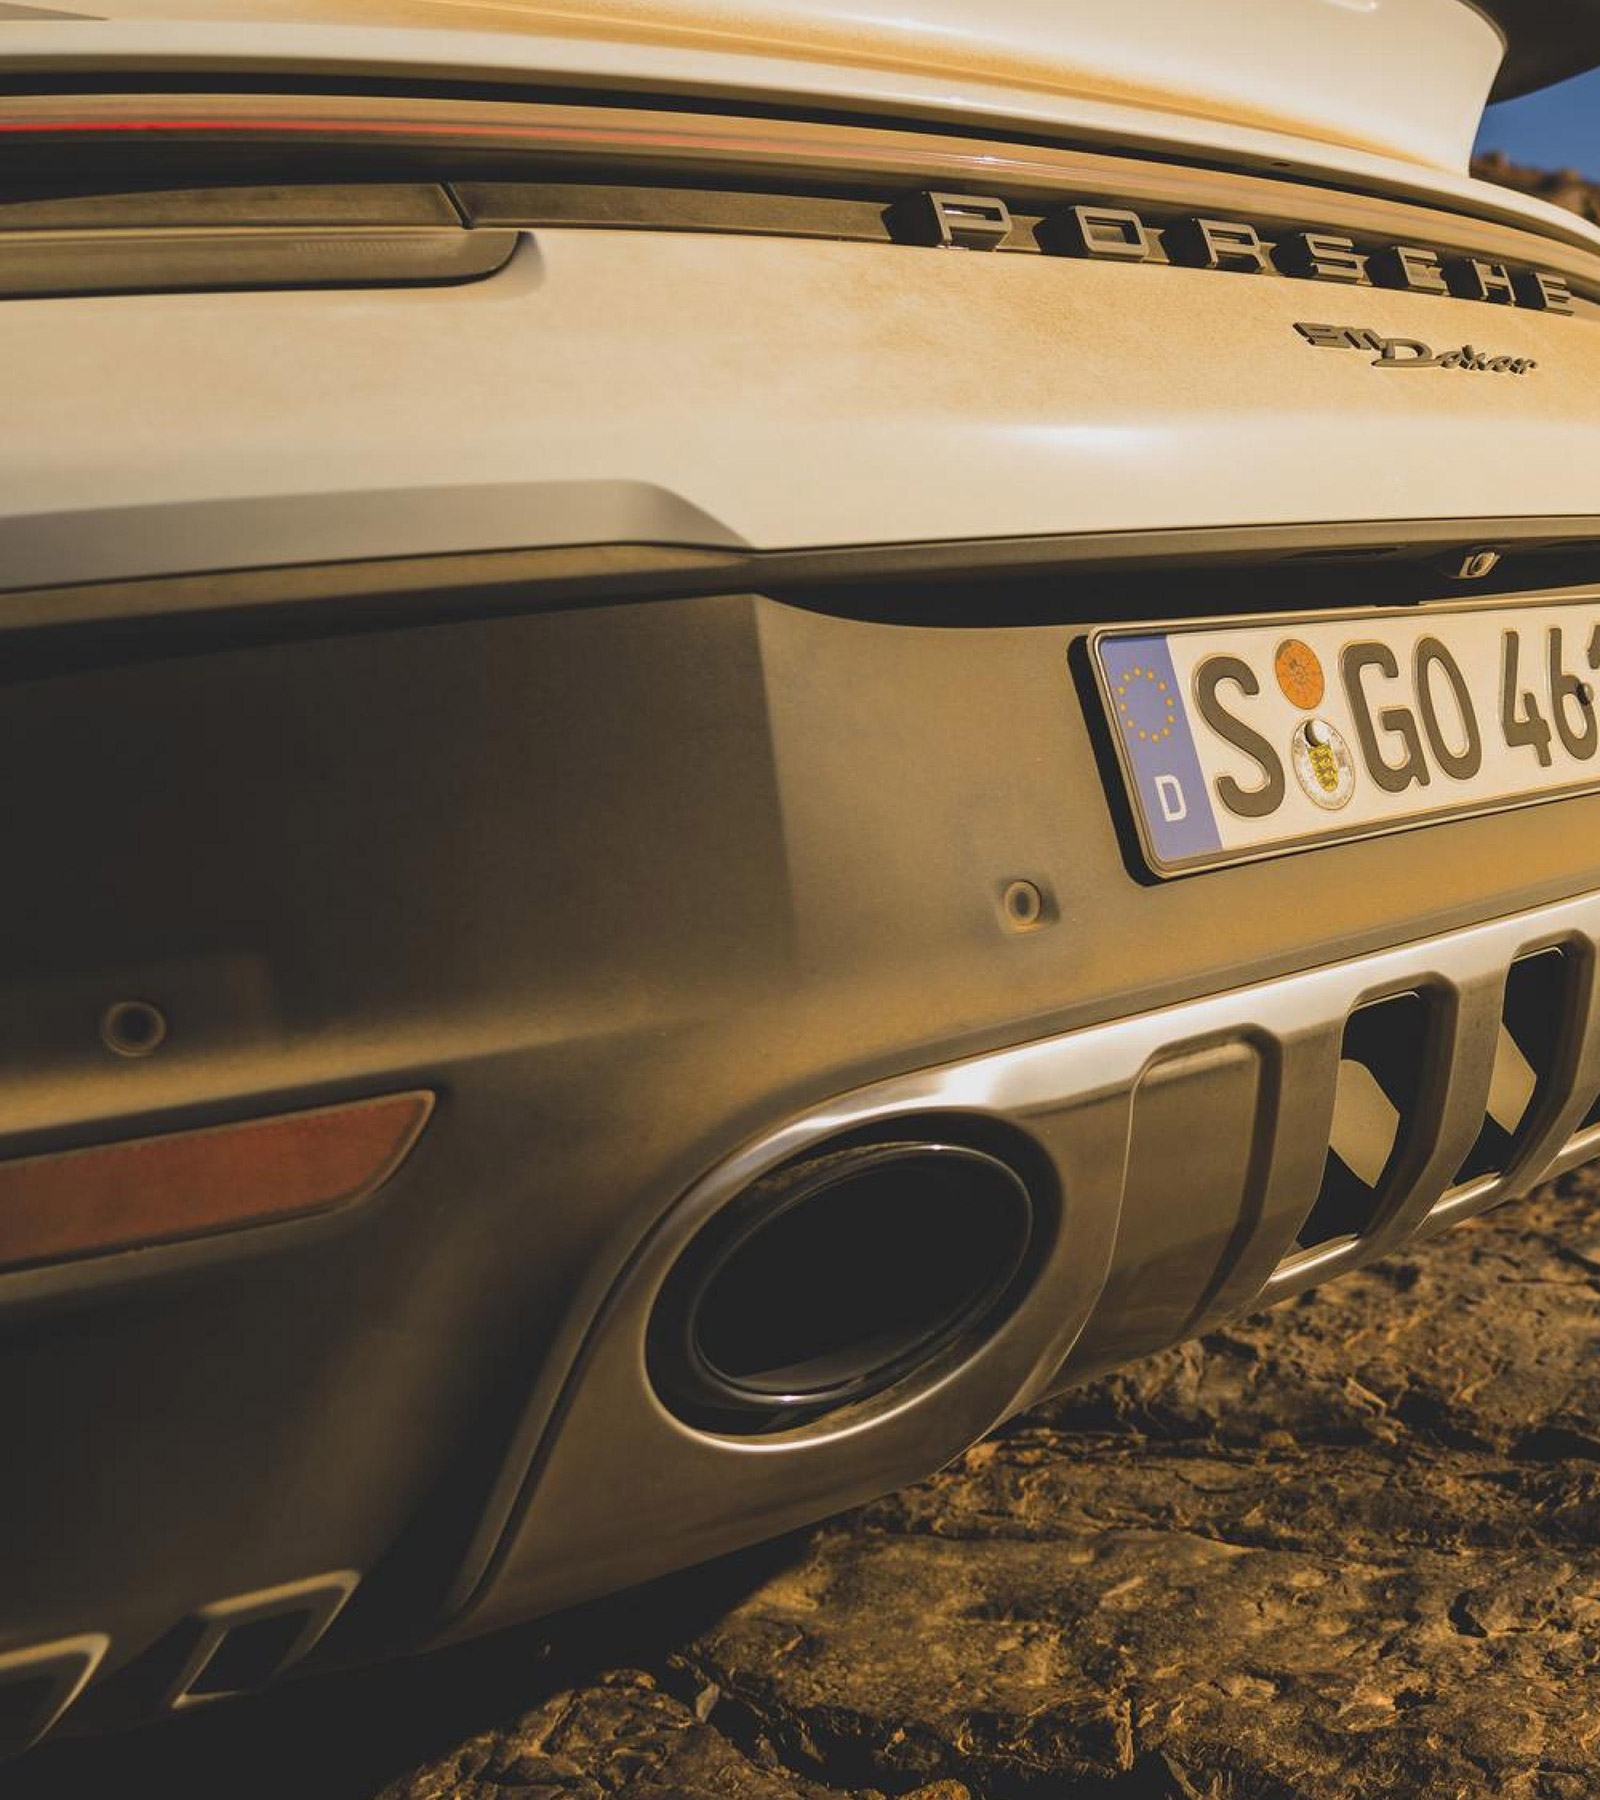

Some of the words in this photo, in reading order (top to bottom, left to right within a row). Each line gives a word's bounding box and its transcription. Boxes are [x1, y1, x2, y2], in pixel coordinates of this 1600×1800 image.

[920, 190, 1576, 315] PORSCHE
[1371, 337, 1539, 374] Dakar
[1196, 655, 1285, 817] S
[1341, 637, 1483, 794] GO
[1155, 775, 1186, 821] D
